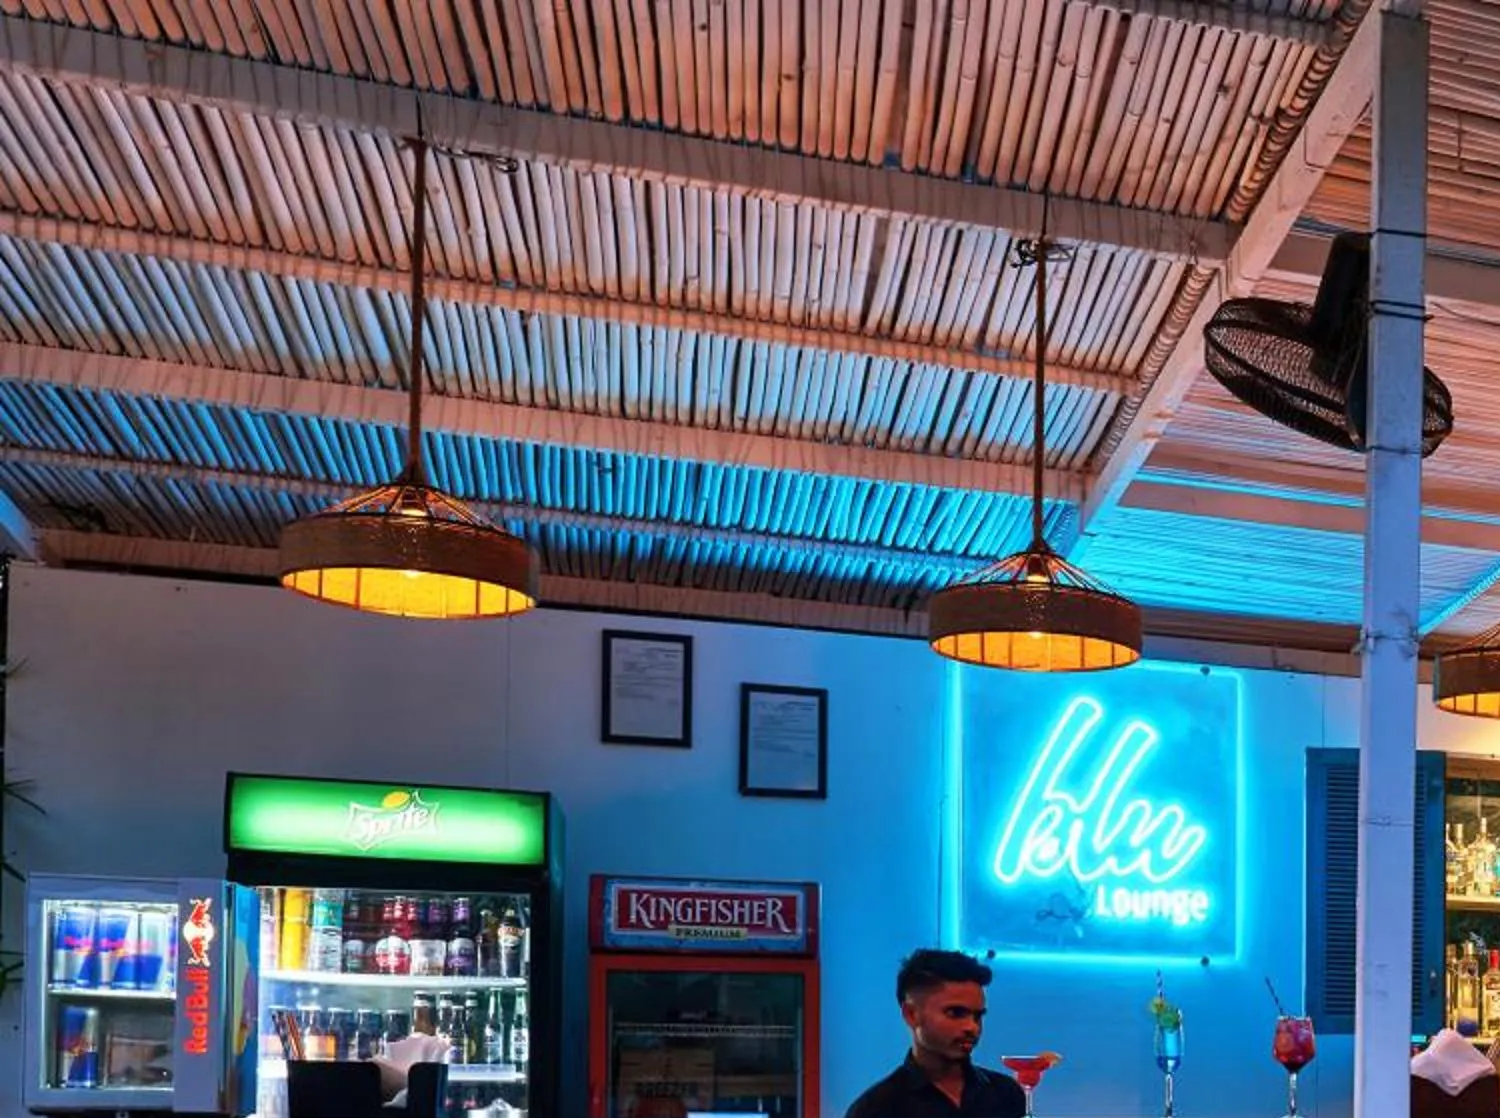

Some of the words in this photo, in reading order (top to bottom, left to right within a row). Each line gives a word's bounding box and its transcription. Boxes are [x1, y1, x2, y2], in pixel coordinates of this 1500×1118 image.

[351, 802, 429, 842] Sprite
[629, 892, 792, 933] KINGFISHER
[1096, 885, 1208, 925] Lounge
[675, 927, 742, 940] PREMIUM
